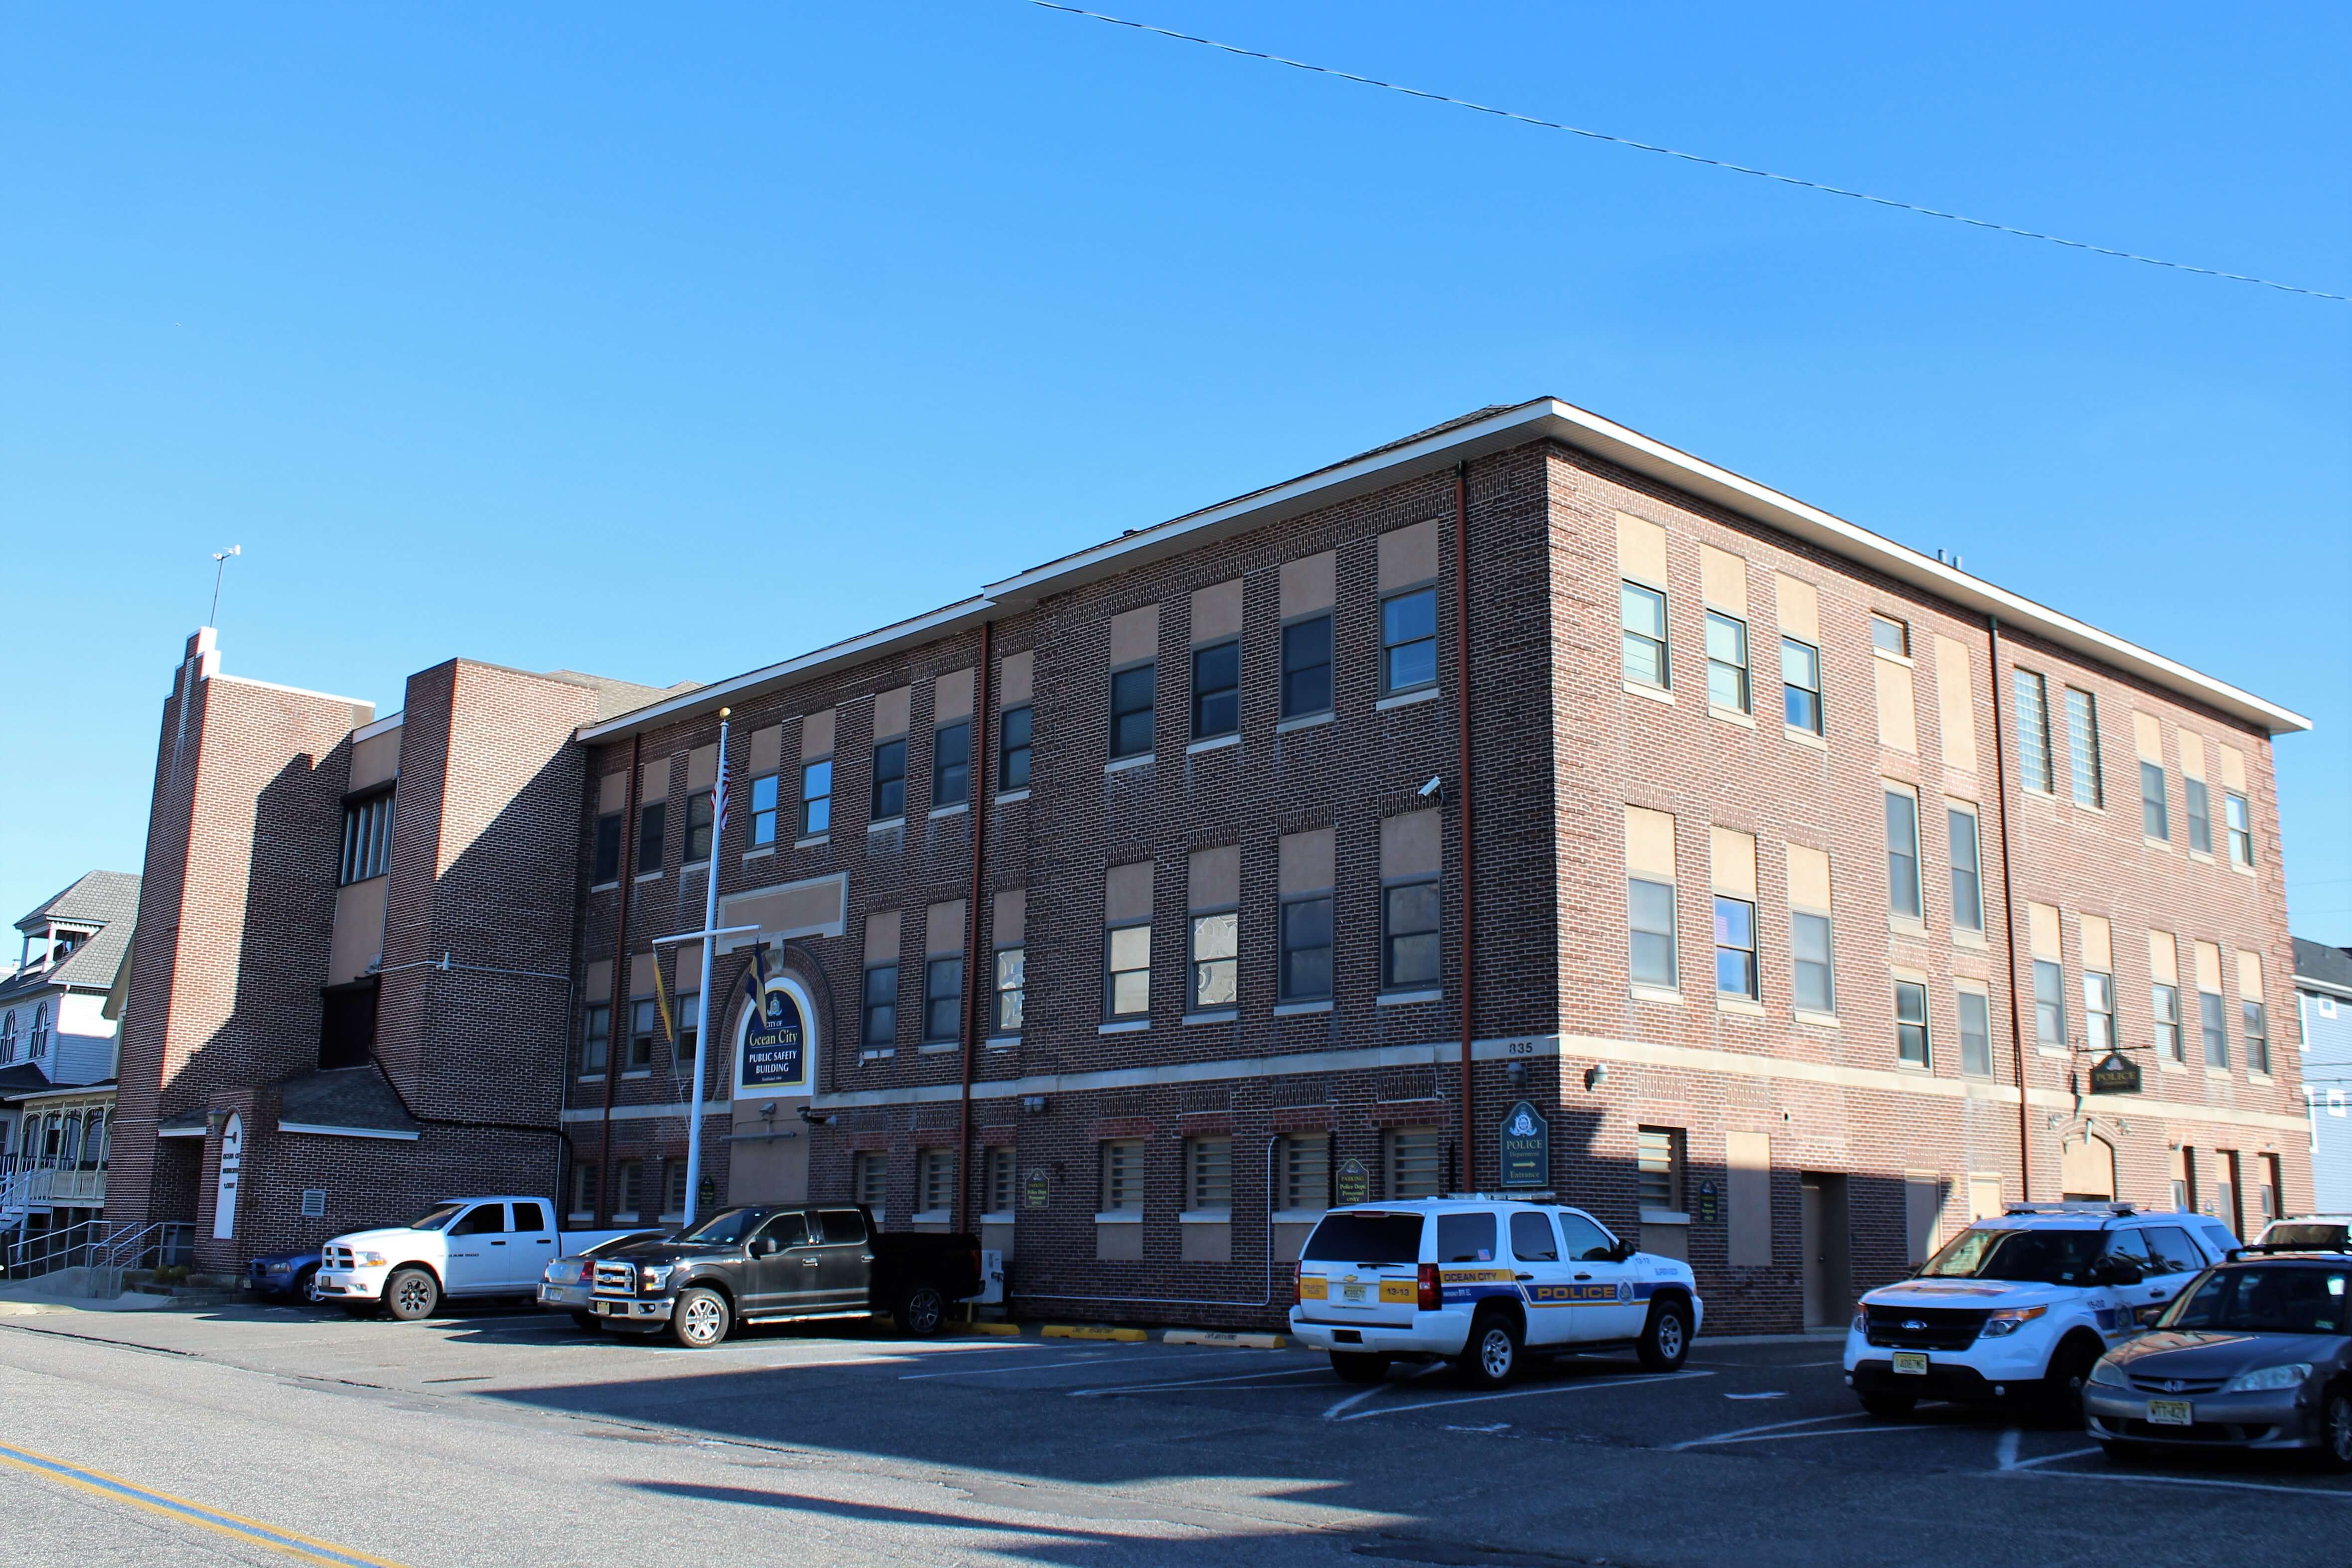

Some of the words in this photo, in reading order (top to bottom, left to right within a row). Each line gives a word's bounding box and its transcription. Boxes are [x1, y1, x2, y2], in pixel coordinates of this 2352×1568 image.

[749, 1030, 775, 1046] Ocean
[778, 1029, 797, 1045] City
[1509, 1042, 1532, 1054] 835
[749, 1052, 772, 1062] PUBLIC
[774, 1050, 797, 1061] SAFETY
[756, 1063, 789, 1074] BUILDING
[2096, 1072, 2137, 1081] POLICE
[1507, 1140, 1542, 1149] POLICE
[1478, 1272, 1497, 1281] CITY
[1537, 1286, 1615, 1299] POLICE
